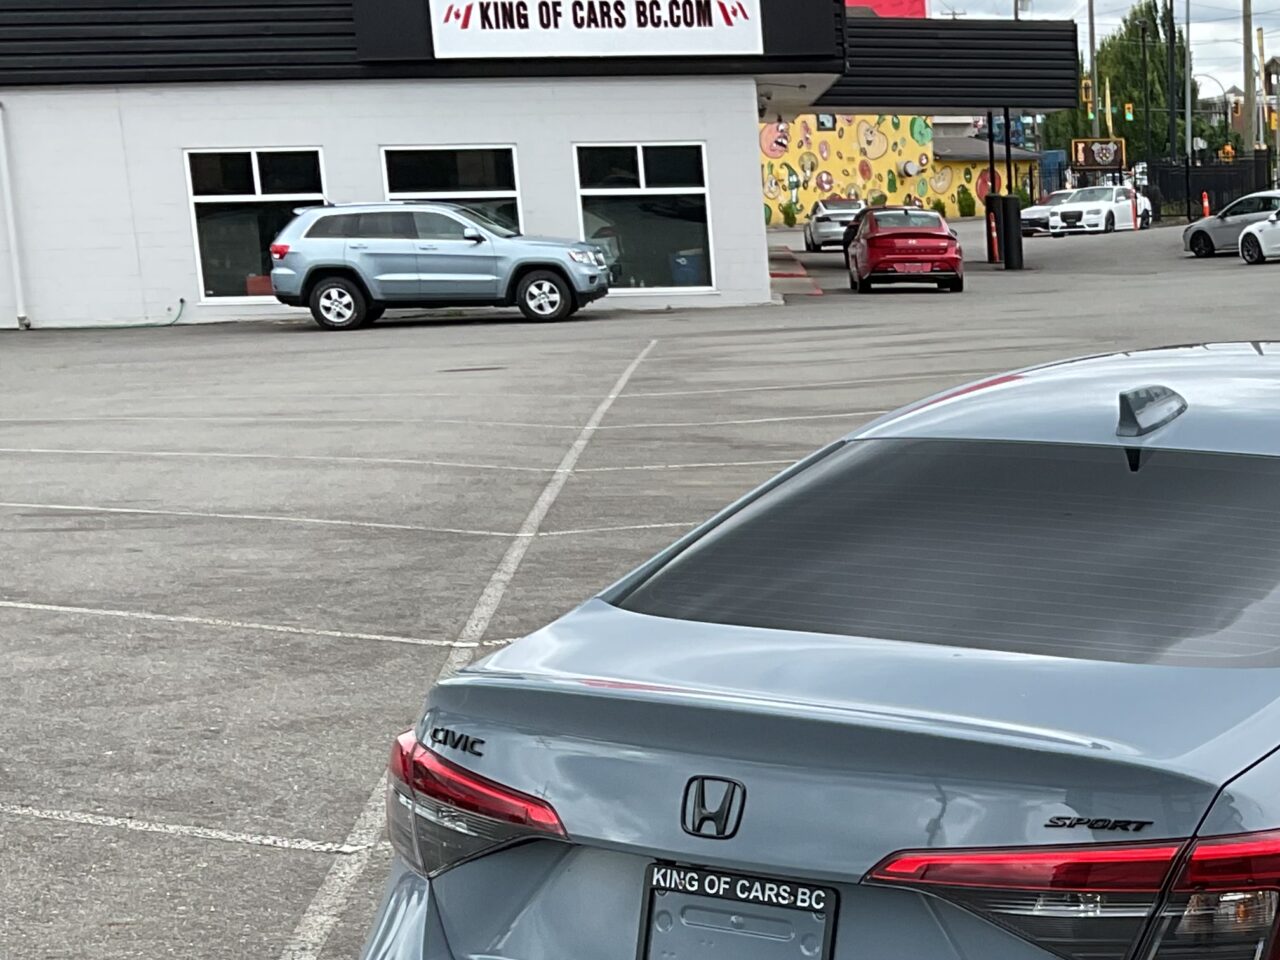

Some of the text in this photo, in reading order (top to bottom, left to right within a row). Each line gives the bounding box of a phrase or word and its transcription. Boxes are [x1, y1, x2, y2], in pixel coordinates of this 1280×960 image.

[479, 0, 714, 30] KING OF CARS BC.COM
[431, 727, 486, 757] CIVIC
[1043, 816, 1155, 832] SPORT
[652, 867, 826, 910] KING OF CARS BC
